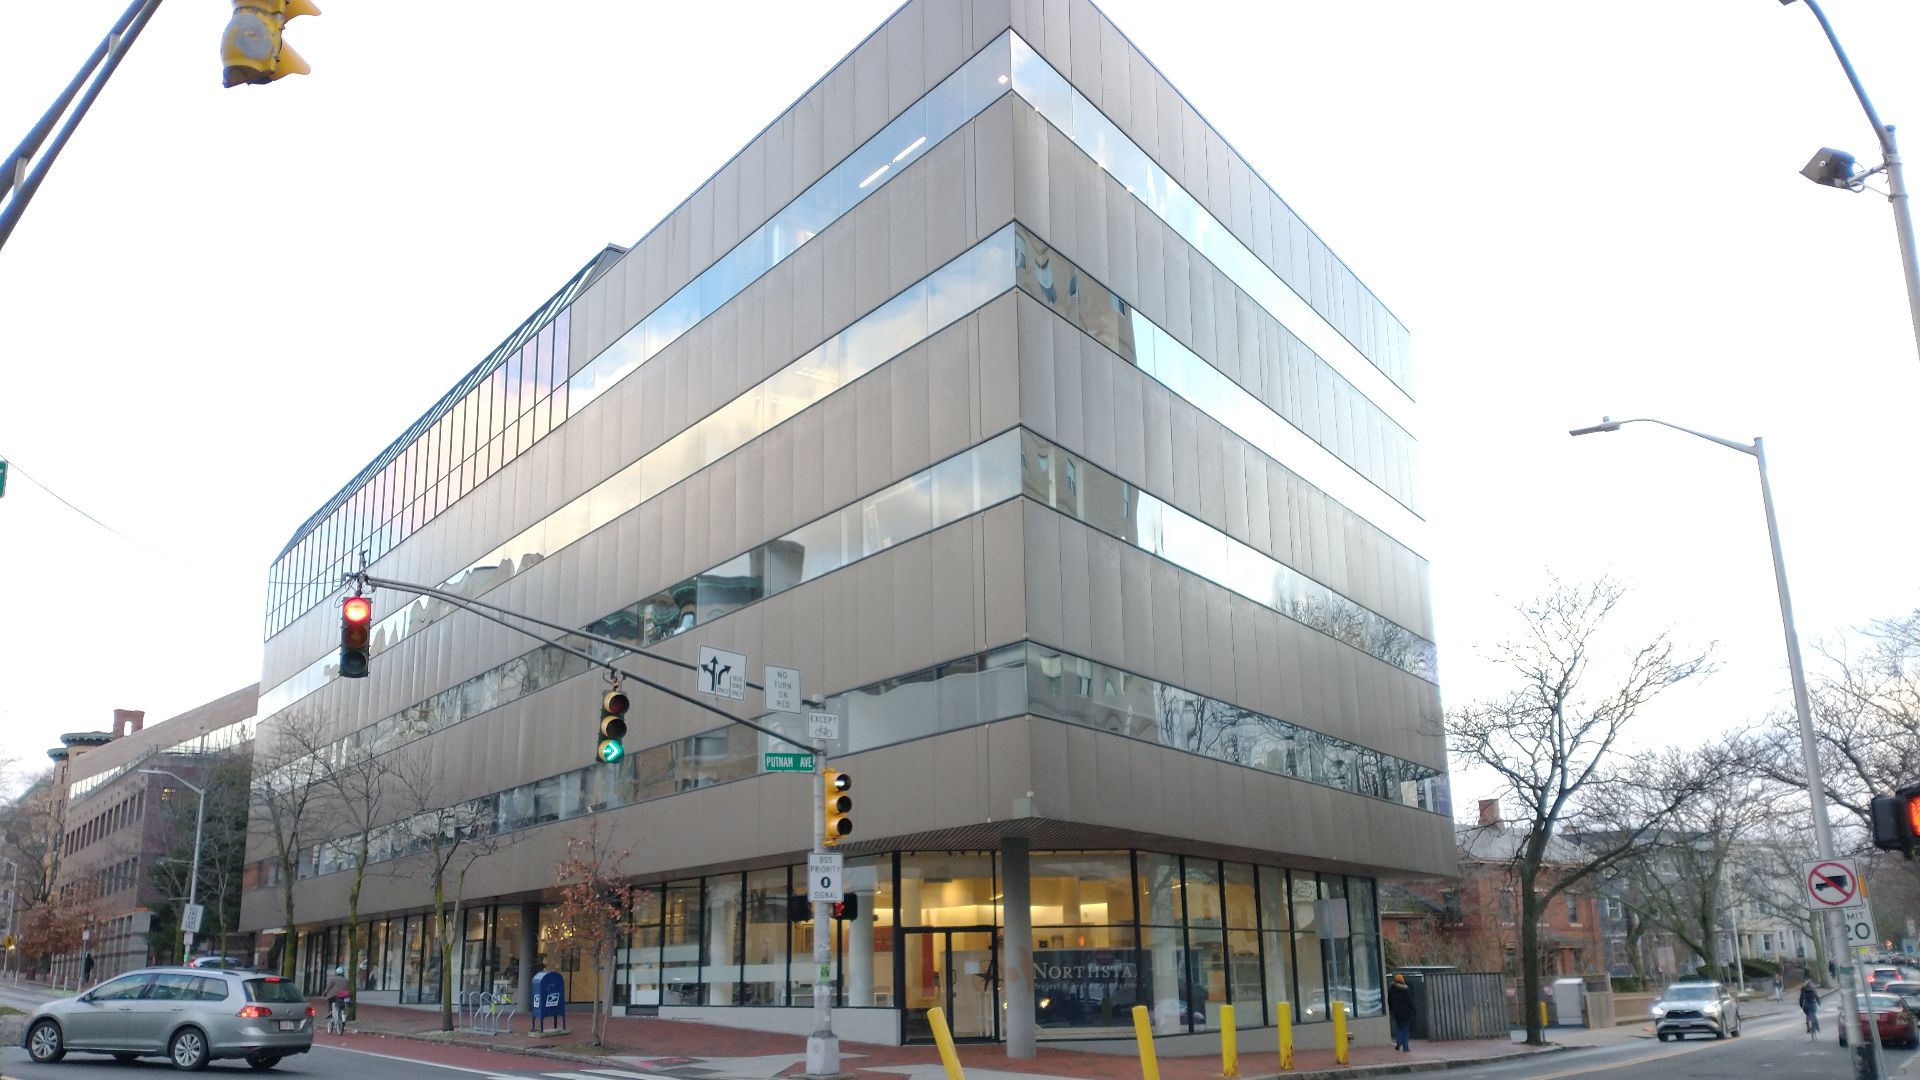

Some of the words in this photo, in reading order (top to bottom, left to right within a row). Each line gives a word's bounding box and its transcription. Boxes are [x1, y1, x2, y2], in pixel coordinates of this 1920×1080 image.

[777, 671, 787, 679] NO
[774, 681, 792, 689] TURN
[776, 699, 791, 708] RED
[810, 714, 837, 724] EXCEPT
[766, 757, 794, 768] PUTNAM
[799, 758, 813, 768] AVE
[819, 856, 832, 864] BUS
[810, 865, 840, 873] PRIORITY
[814, 891, 838, 899] SIGNAL
[1837, 911, 1864, 920] MIT
[1033, 962, 1137, 979] NORTHSTA
